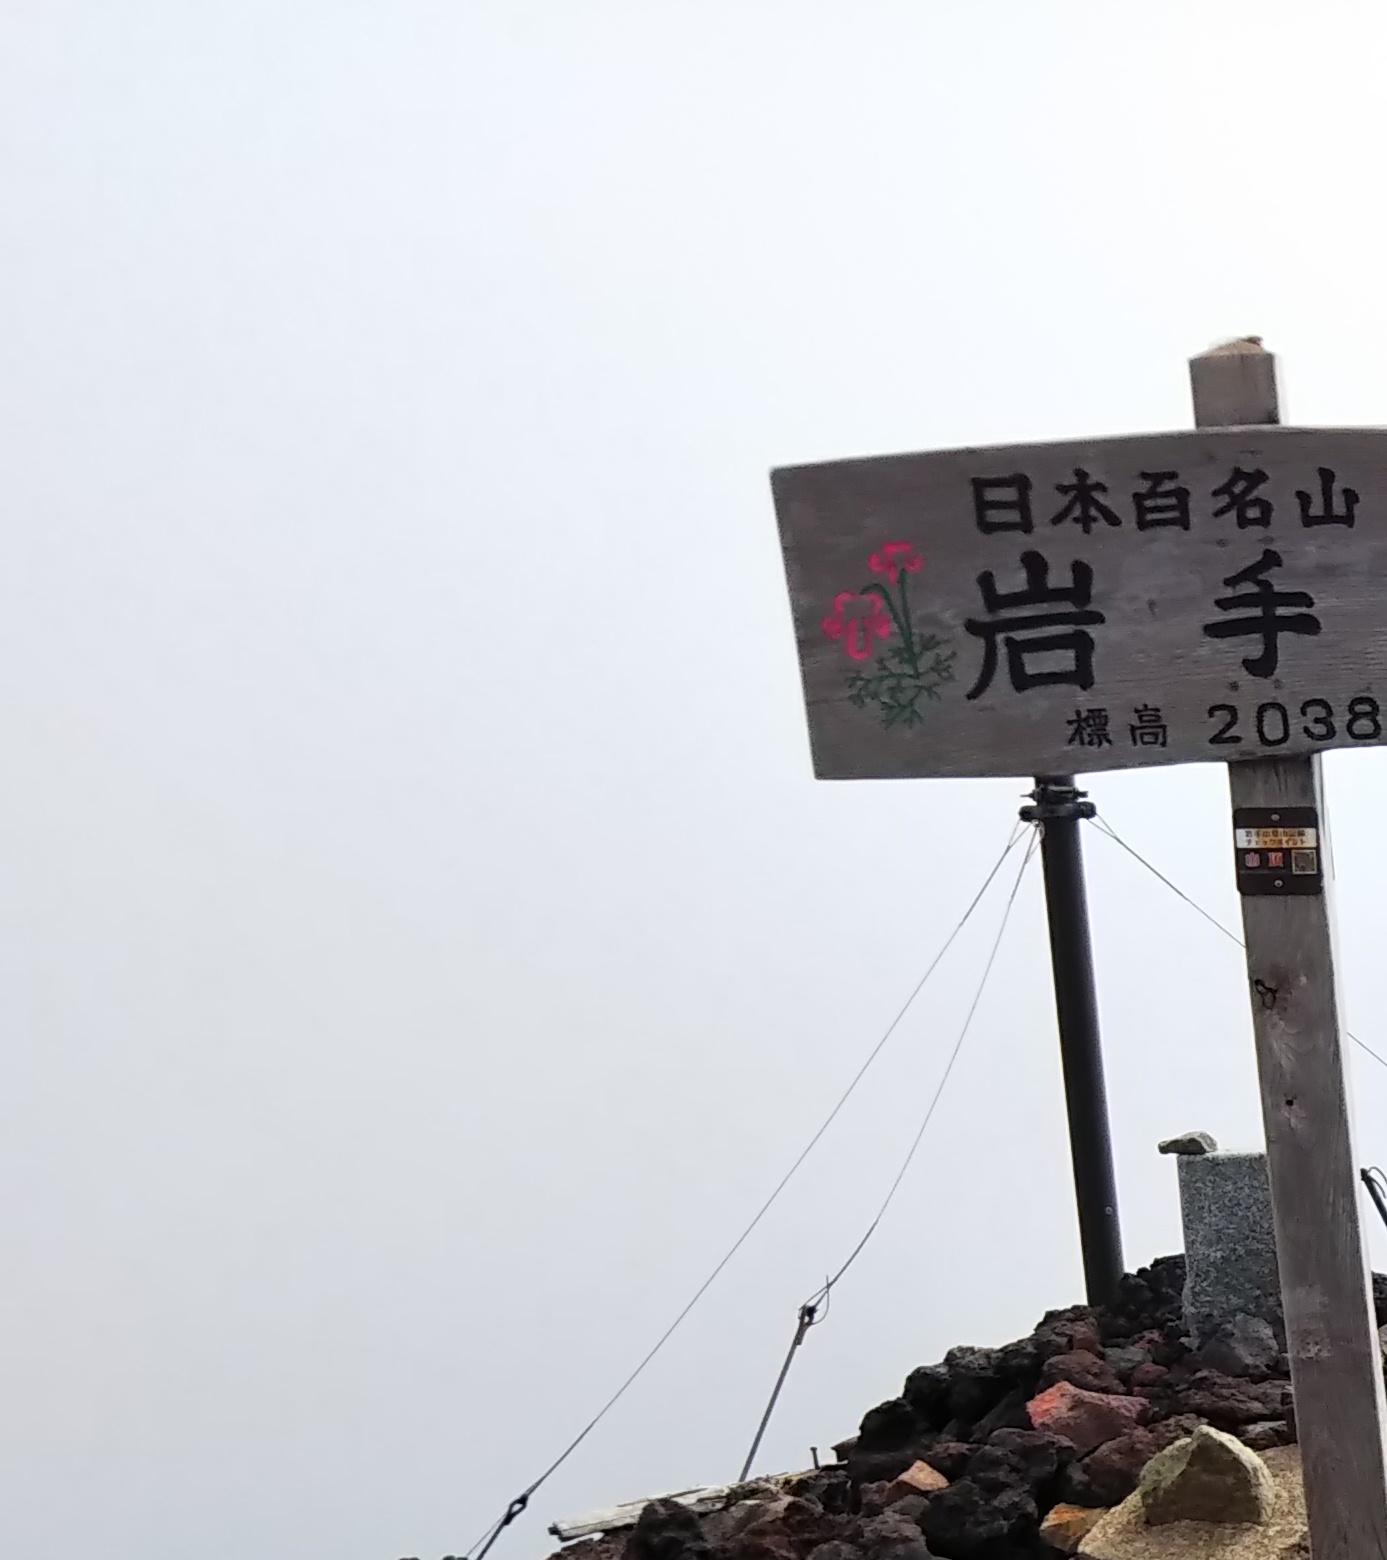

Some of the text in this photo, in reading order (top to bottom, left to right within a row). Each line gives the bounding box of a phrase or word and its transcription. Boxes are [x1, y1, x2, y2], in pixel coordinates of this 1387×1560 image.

[969, 466, 1360, 535] 日本百名山
[1066, 704, 1167, 748] 標高
